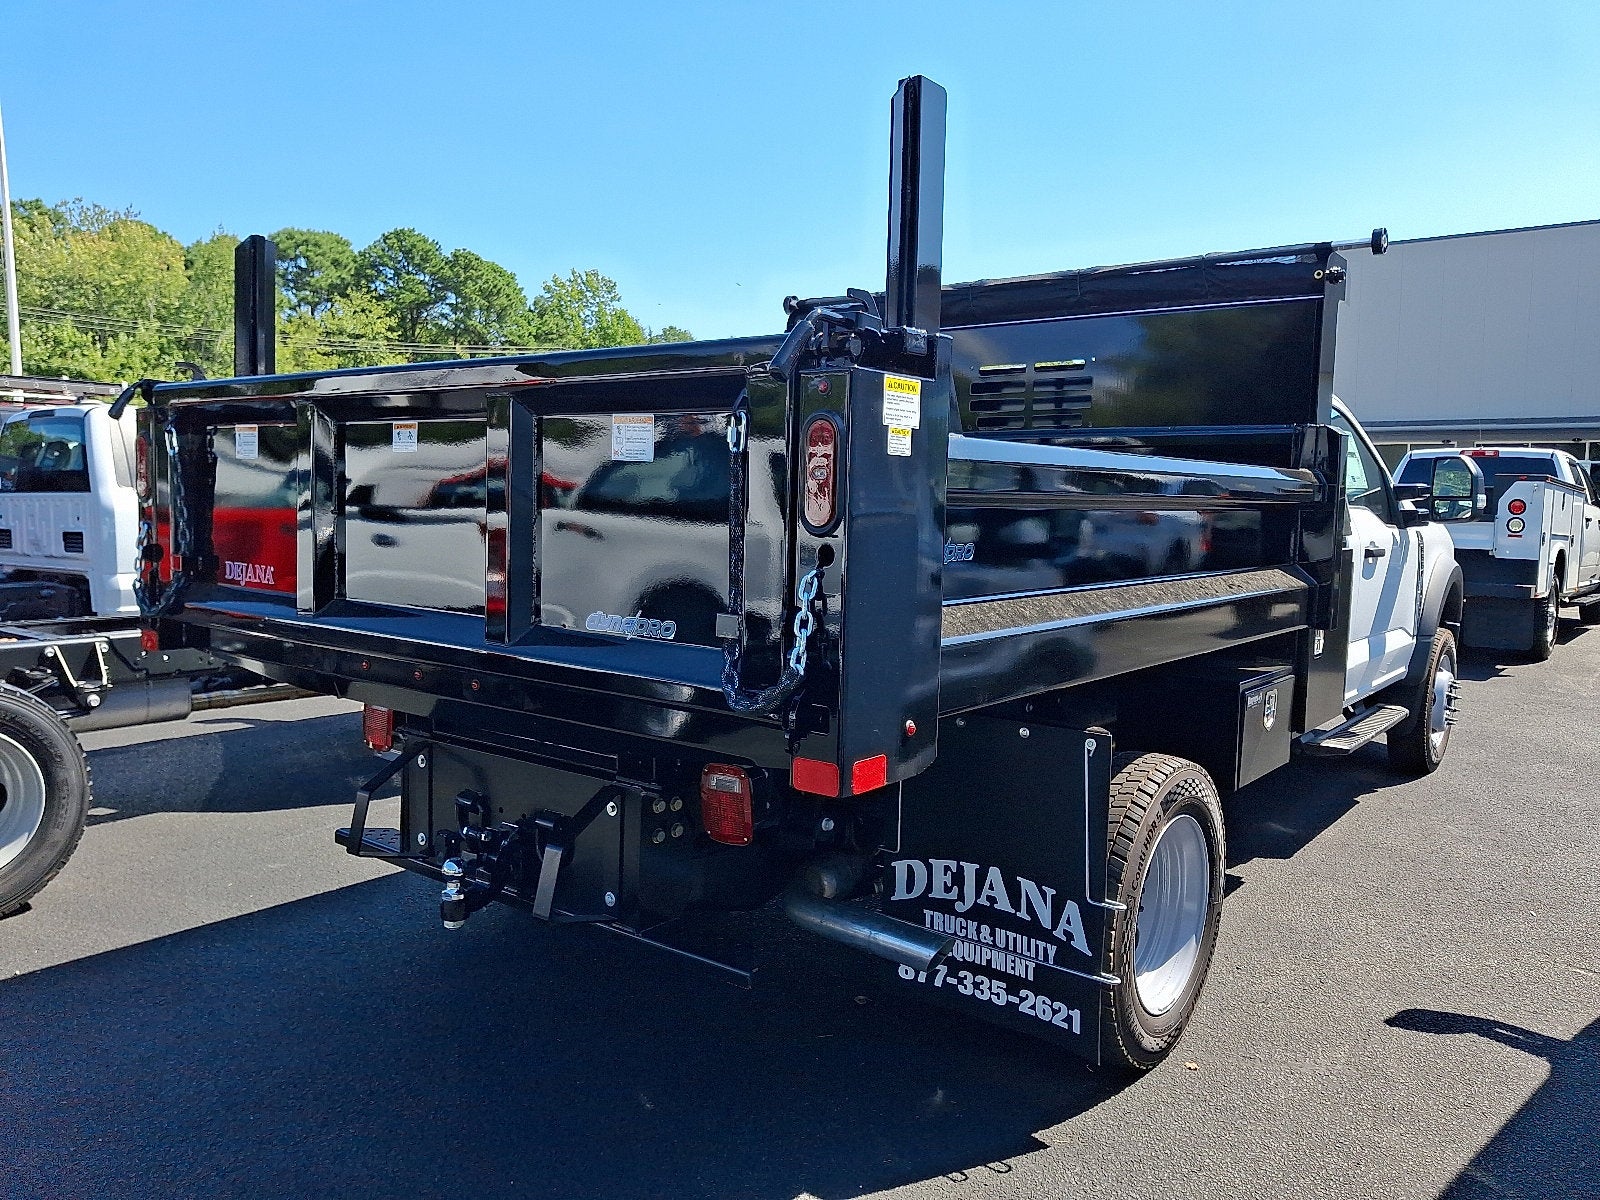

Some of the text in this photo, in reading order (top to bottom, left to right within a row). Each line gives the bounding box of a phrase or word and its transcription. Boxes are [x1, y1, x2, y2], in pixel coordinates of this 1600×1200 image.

[224, 561, 274, 586] DEJANA
[891, 858, 1093, 957] DEJANA
[923, 909, 979, 941] TRUCK
[995, 927, 1058, 965] UTILITY
[948, 939, 1036, 982] QUIPMENT
